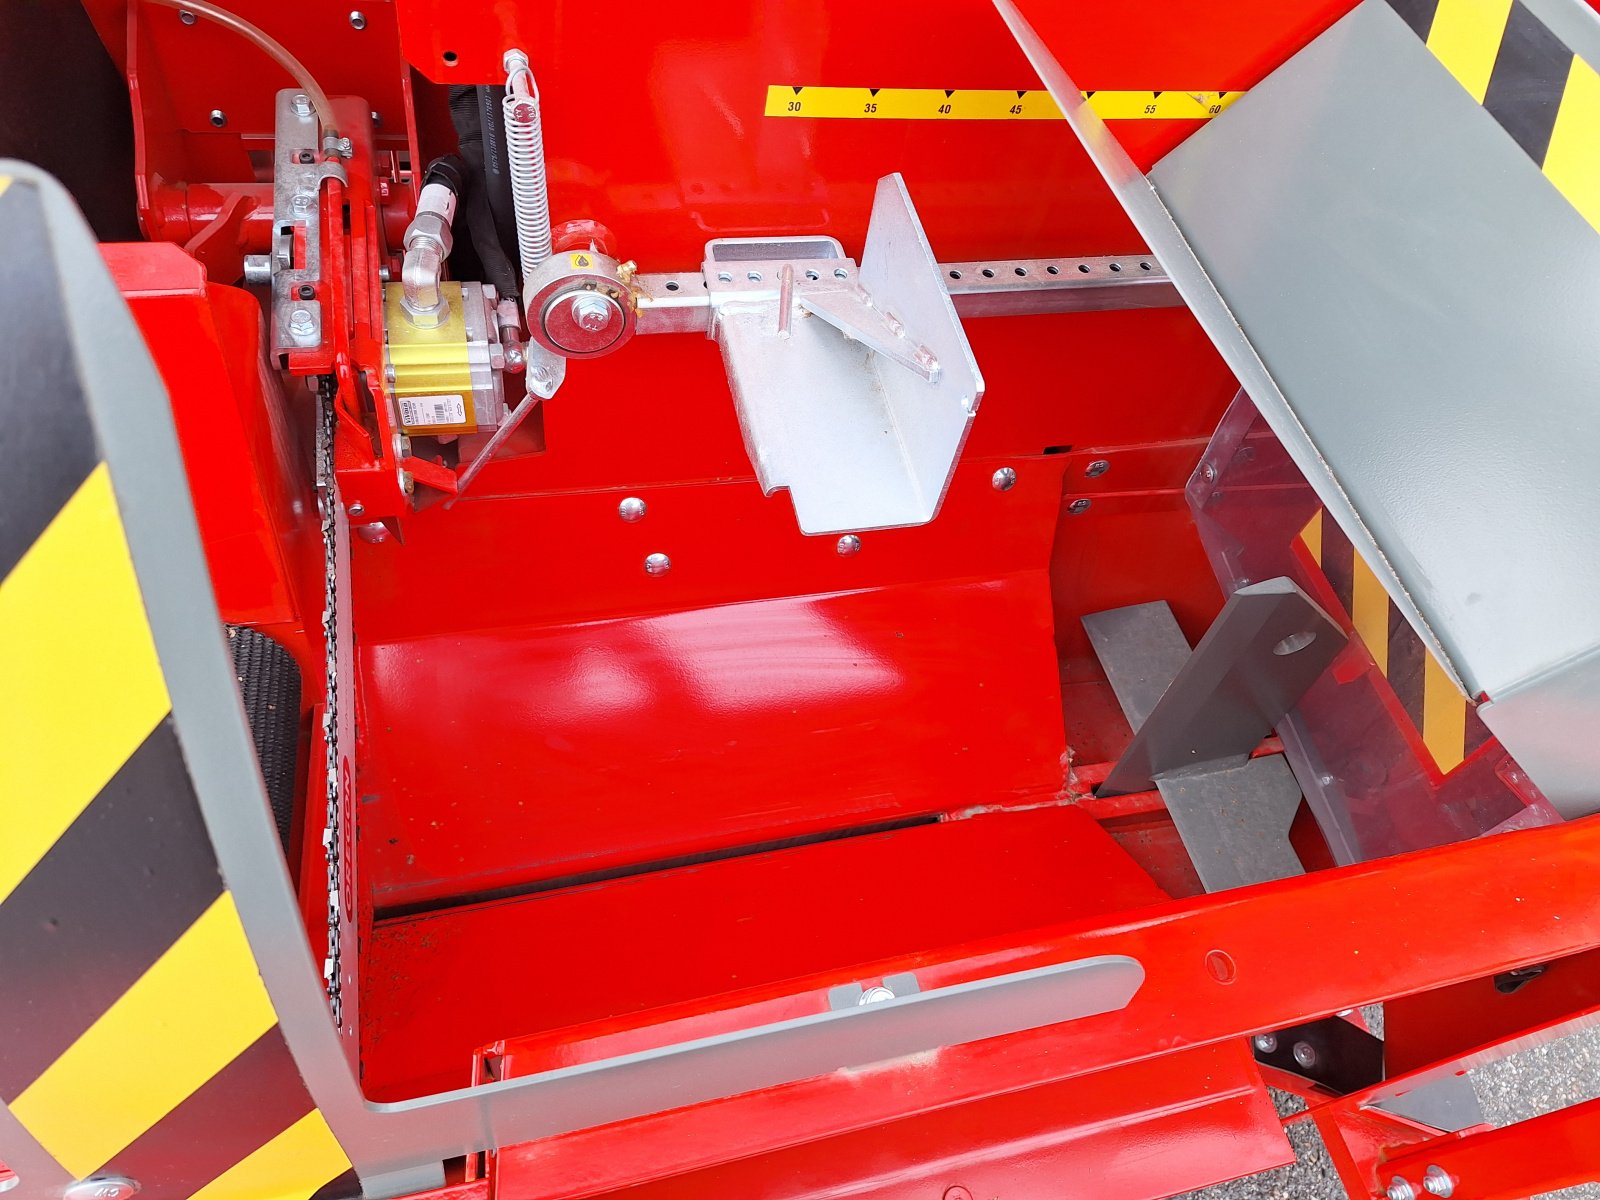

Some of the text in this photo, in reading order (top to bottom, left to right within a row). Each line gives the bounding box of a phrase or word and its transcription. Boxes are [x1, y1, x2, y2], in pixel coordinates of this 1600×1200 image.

[788, 101, 1222, 114] 30 35 40 45 55 60
